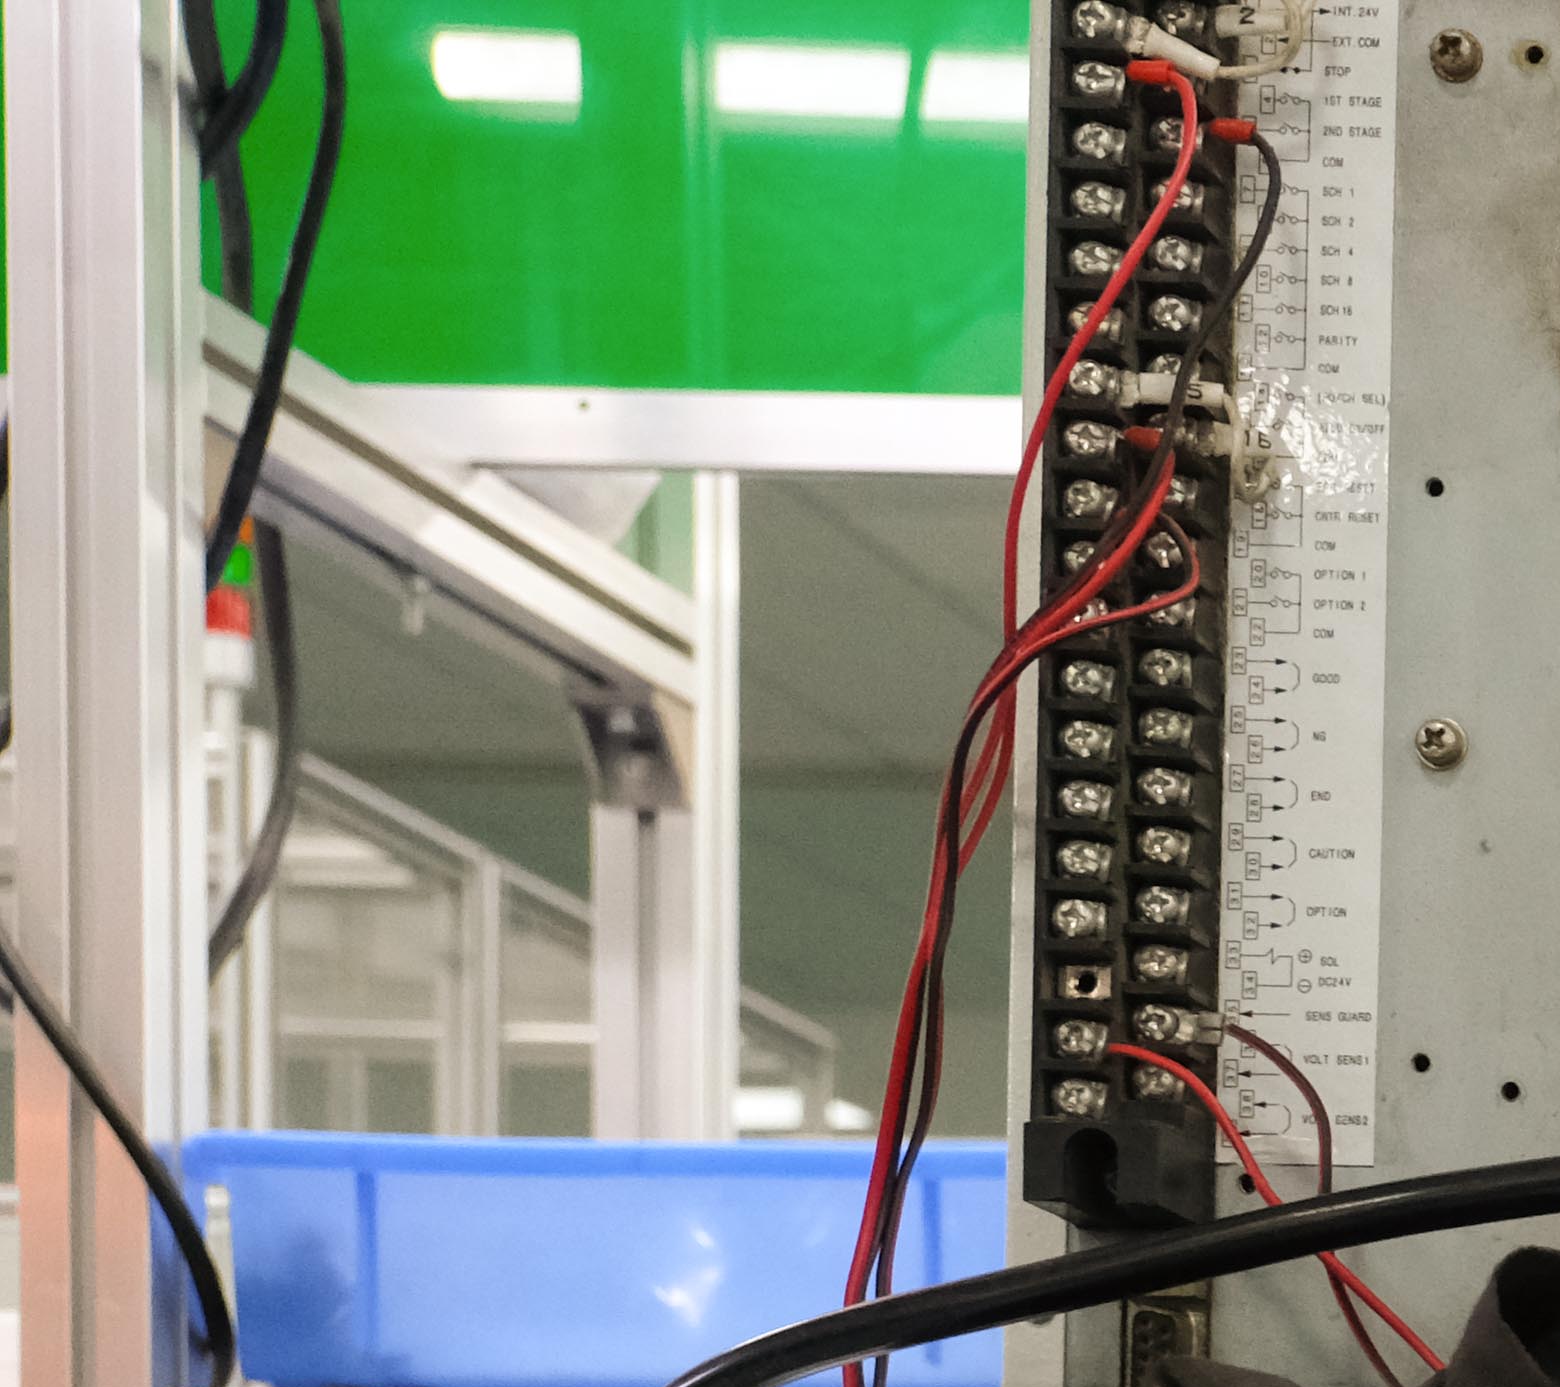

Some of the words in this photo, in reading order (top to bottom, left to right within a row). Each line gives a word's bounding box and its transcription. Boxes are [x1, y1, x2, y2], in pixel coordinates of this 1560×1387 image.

[1324, 66, 1352, 77] STOP
[1350, 97, 1382, 108] STAGE
[1322, 126, 1343, 137] 2ND
[1350, 127, 1382, 138] STAGE
[1322, 186, 1342, 197] SCH
[1321, 246, 1340, 256] SCH
[1320, 275, 1340, 286] SCH
[1318, 335, 1358, 346] PARITY
[1314, 570, 1355, 581] OPTION
[1313, 599, 1354, 610] OPTION
[1312, 673, 1341, 684] GOOD
[1311, 790, 1331, 801] END
[1308, 848, 1355, 859] CAUTION
[1306, 907, 1346, 917] OPTION
[1338, 1011, 1372, 1022] GUARD
[1303, 1055, 1328, 1065] VOLT
